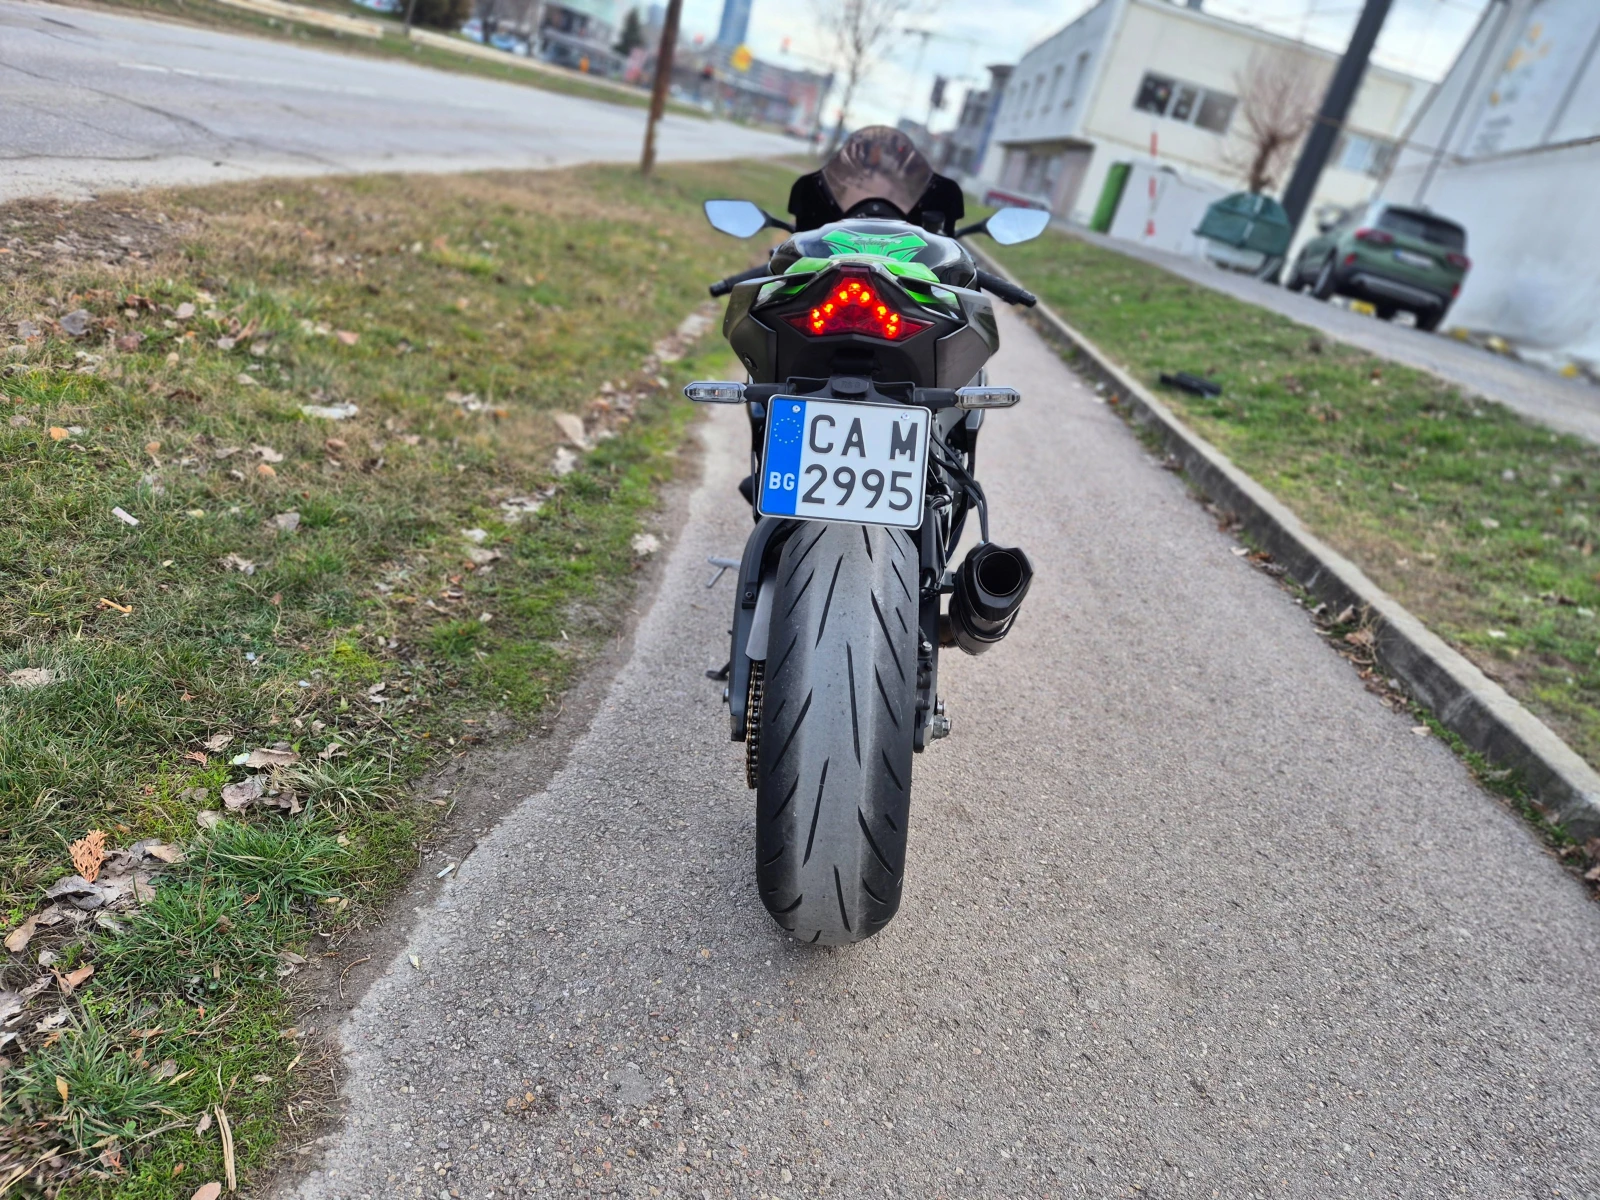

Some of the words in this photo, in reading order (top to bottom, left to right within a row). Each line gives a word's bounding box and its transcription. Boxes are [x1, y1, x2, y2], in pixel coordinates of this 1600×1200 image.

[808, 414, 866, 458] CA
[889, 420, 919, 462] M
[768, 471, 796, 491] BG
[801, 463, 913, 511] 2995
